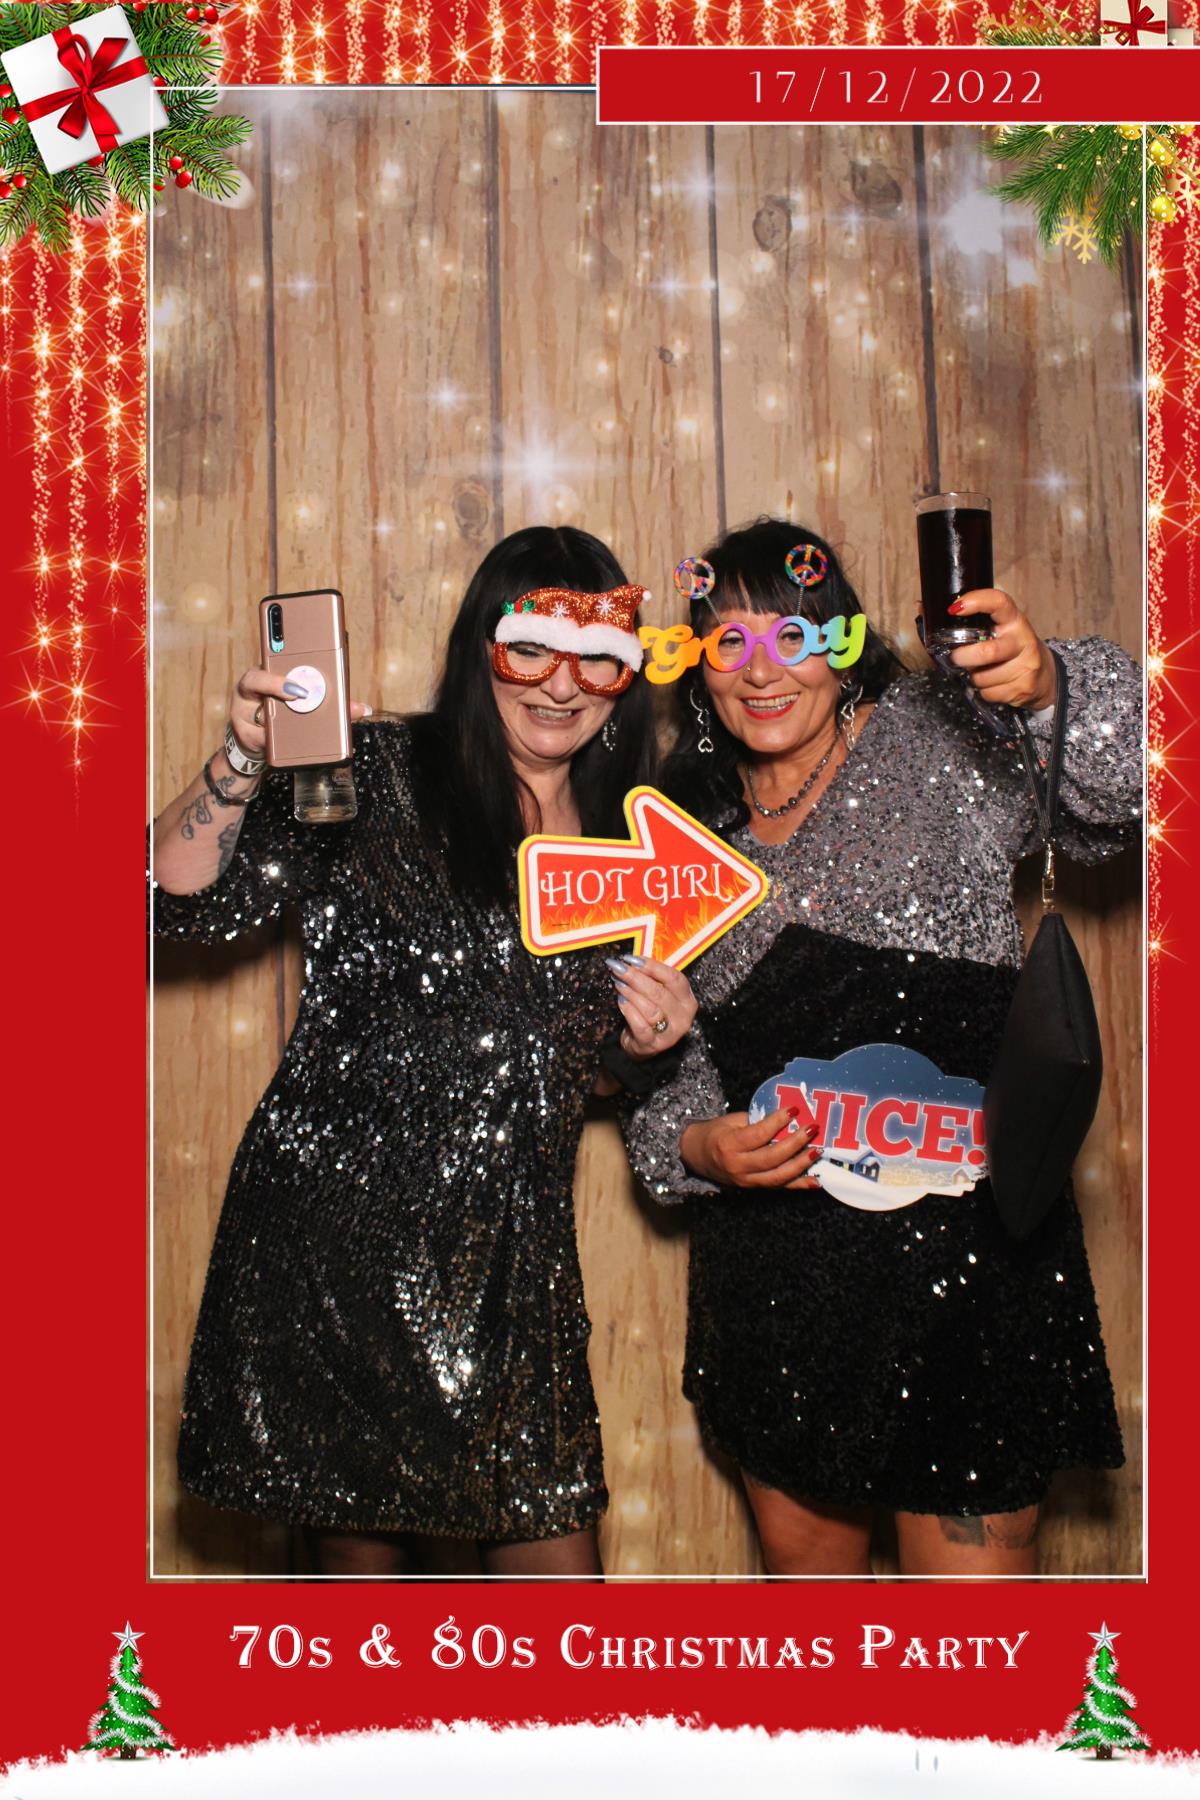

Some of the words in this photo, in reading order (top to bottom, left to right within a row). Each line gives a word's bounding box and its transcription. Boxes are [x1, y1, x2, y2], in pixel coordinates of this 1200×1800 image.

[540, 866, 634, 906] HOT
[642, 862, 737, 906] GIRL
[774, 1083, 985, 1166] NICE!
